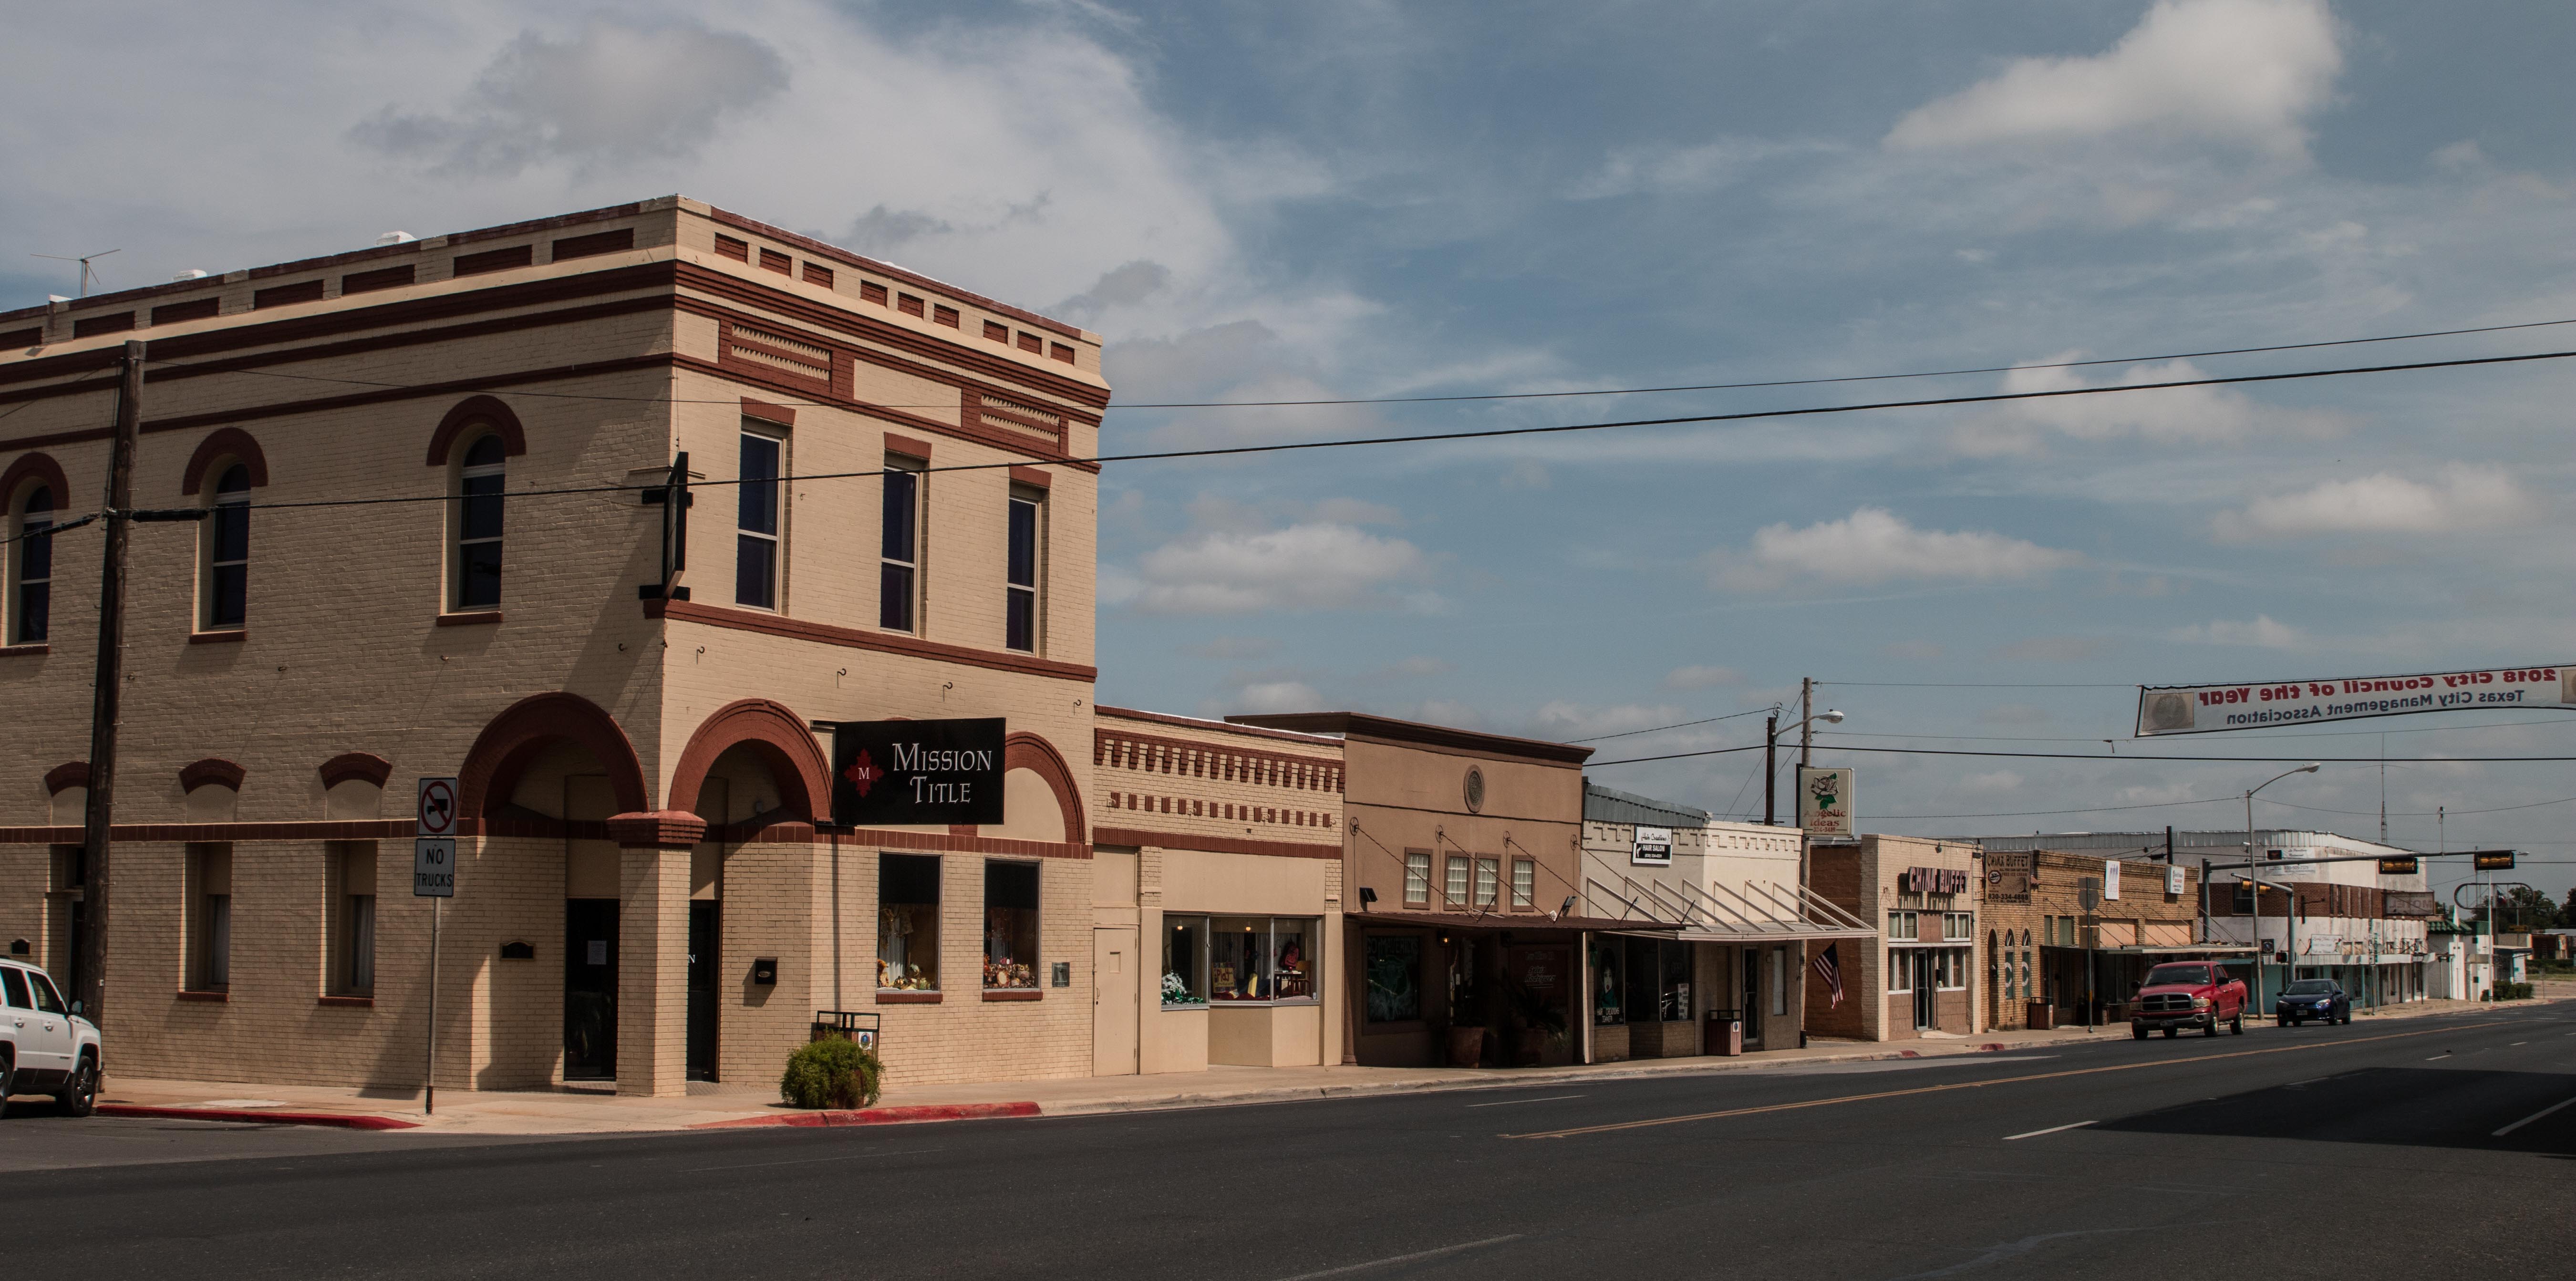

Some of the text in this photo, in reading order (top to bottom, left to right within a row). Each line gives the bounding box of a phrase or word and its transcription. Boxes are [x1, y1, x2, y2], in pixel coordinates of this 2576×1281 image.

[858, 767, 870, 780] M
[1803, 809, 1846, 818] Angelic
[1810, 817, 1840, 826] Ideas
[426, 848, 444, 865] NO
[2006, 855, 2028, 867] BUFFET
[416, 873, 453, 888] TRUCKS
[1909, 868, 1970, 893] CHINA BUFFET
[1216, 968, 1230, 981] Play
